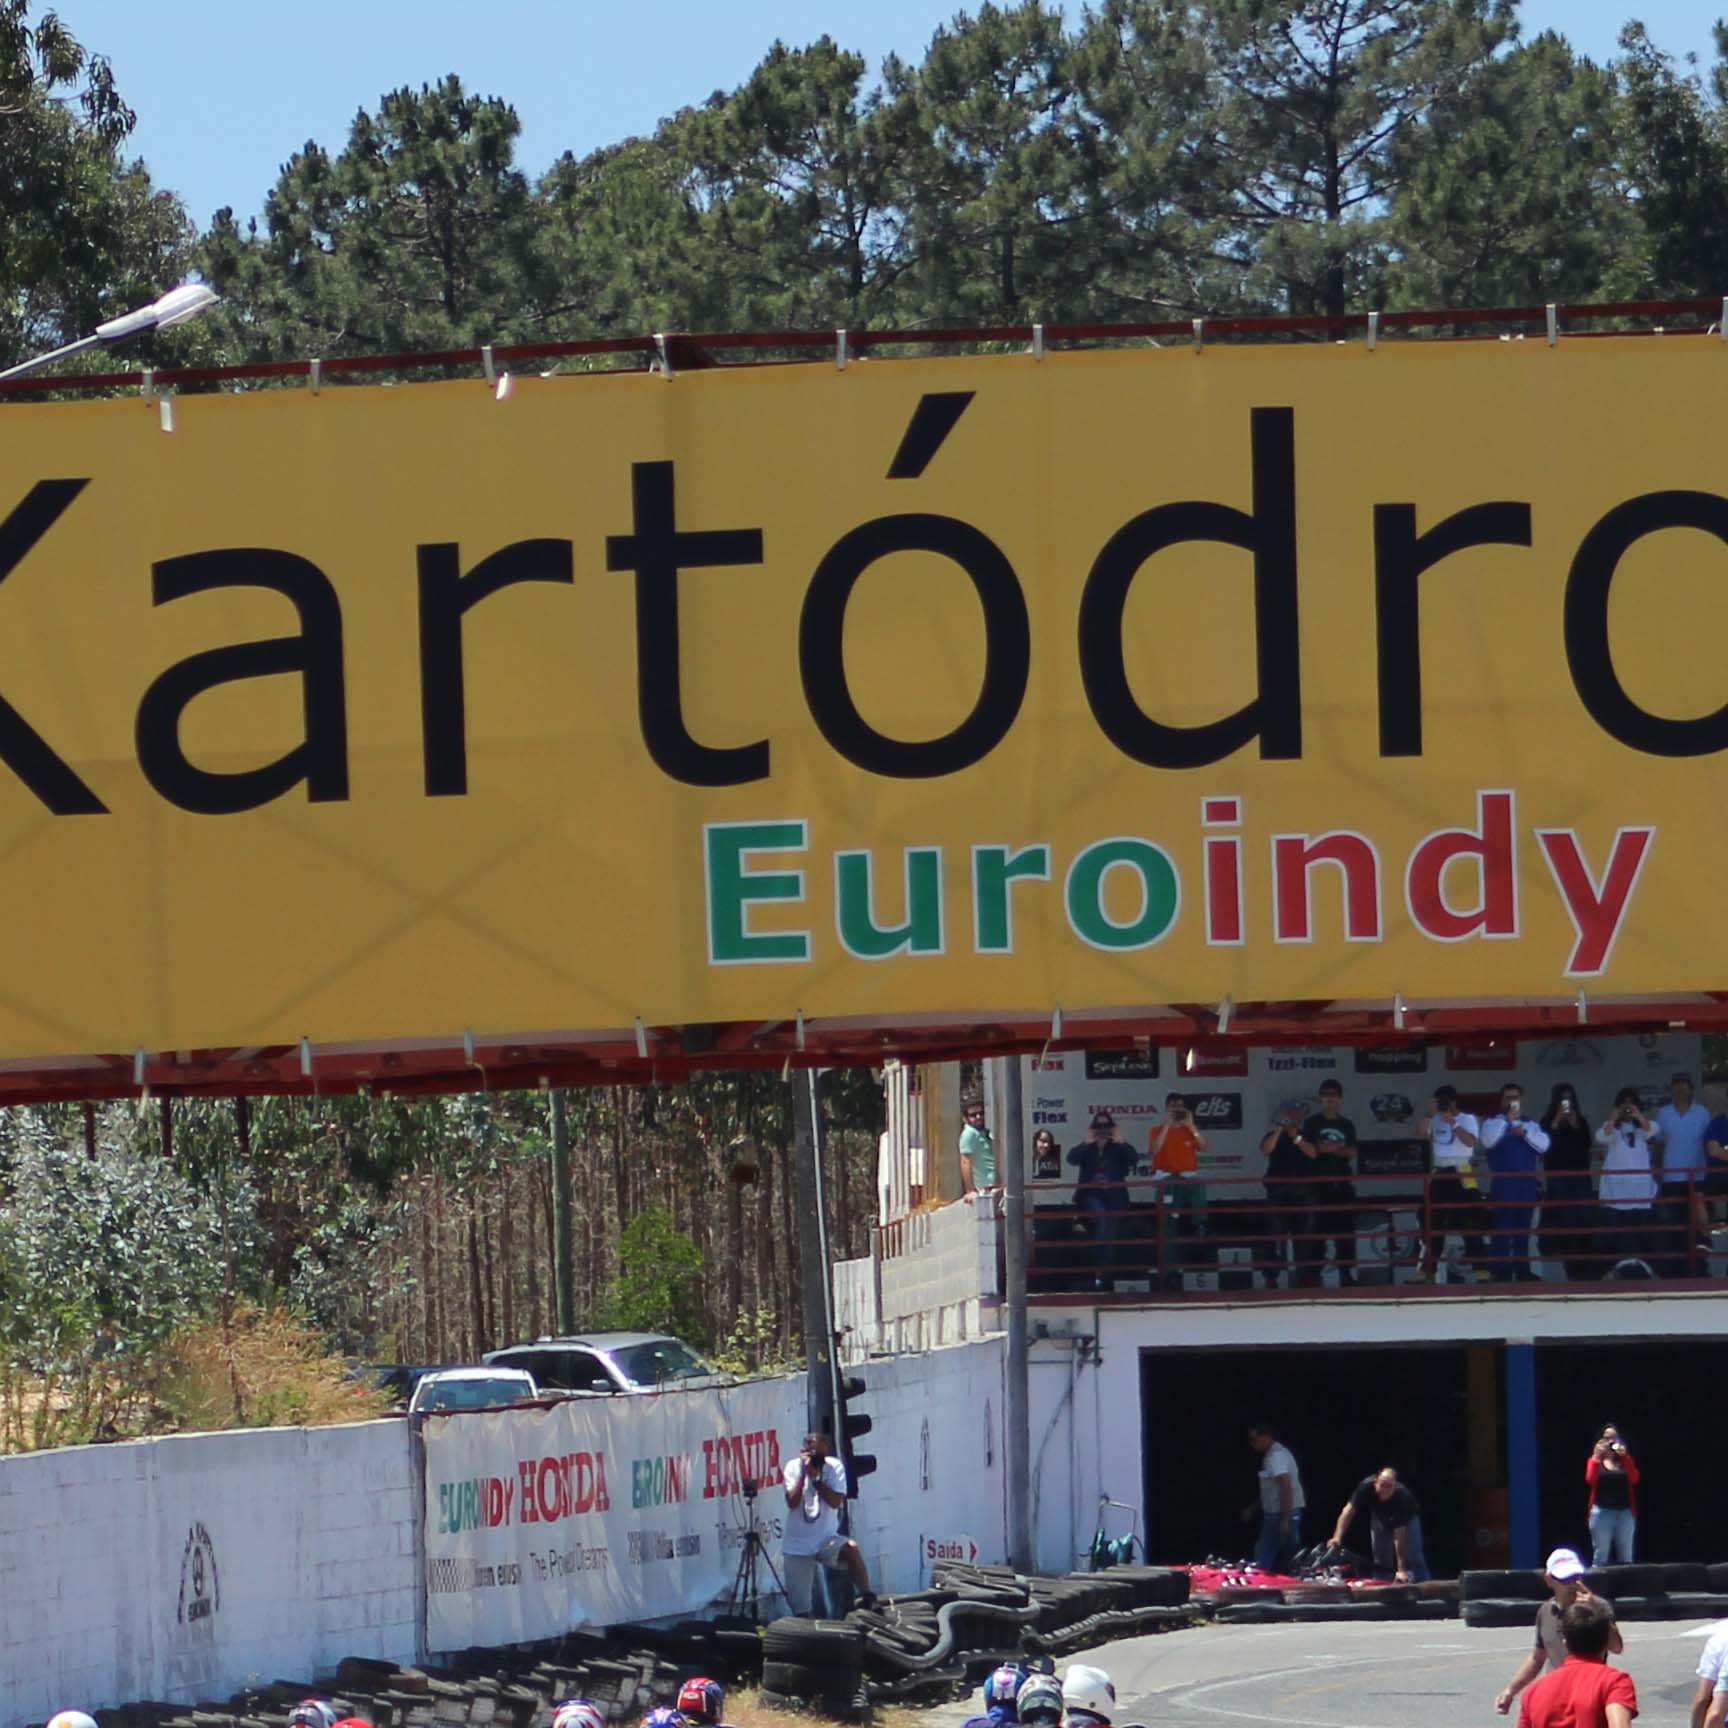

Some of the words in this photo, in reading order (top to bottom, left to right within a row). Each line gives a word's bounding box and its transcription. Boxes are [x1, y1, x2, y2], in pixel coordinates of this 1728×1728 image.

[703, 788, 1655, 976] Euroindy
[1032, 1111, 1068, 1125] Flex
[1088, 1104, 1158, 1115] HONDA
[518, 1451, 611, 1524] HONDA
